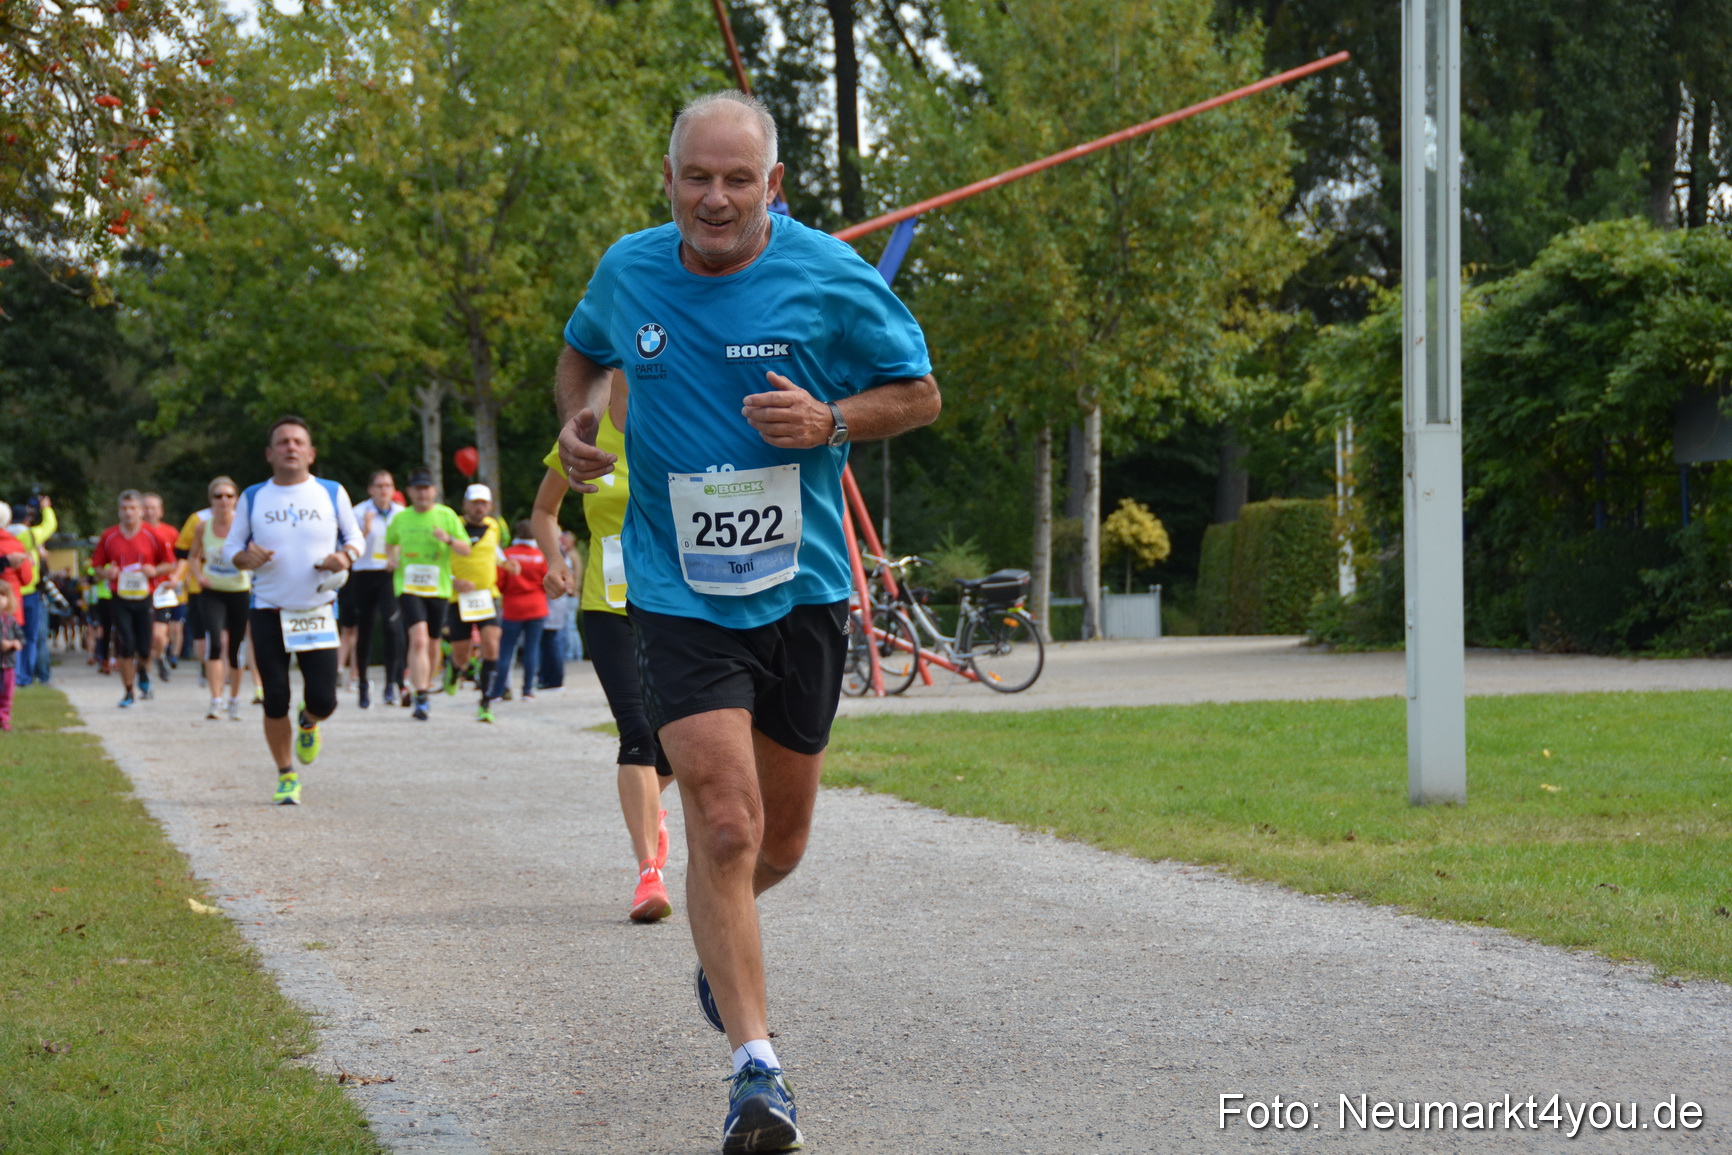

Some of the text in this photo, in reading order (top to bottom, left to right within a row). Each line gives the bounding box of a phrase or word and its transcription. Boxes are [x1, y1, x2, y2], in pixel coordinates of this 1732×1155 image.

[638, 324, 665, 336] BMW
[726, 343, 790, 358] BOCK
[635, 363, 667, 373] PARTL
[717, 480, 765, 494] BOCK
[692, 505, 784, 547] 2522
[727, 559, 754, 574] Toni
[289, 616, 327, 632] 2057
